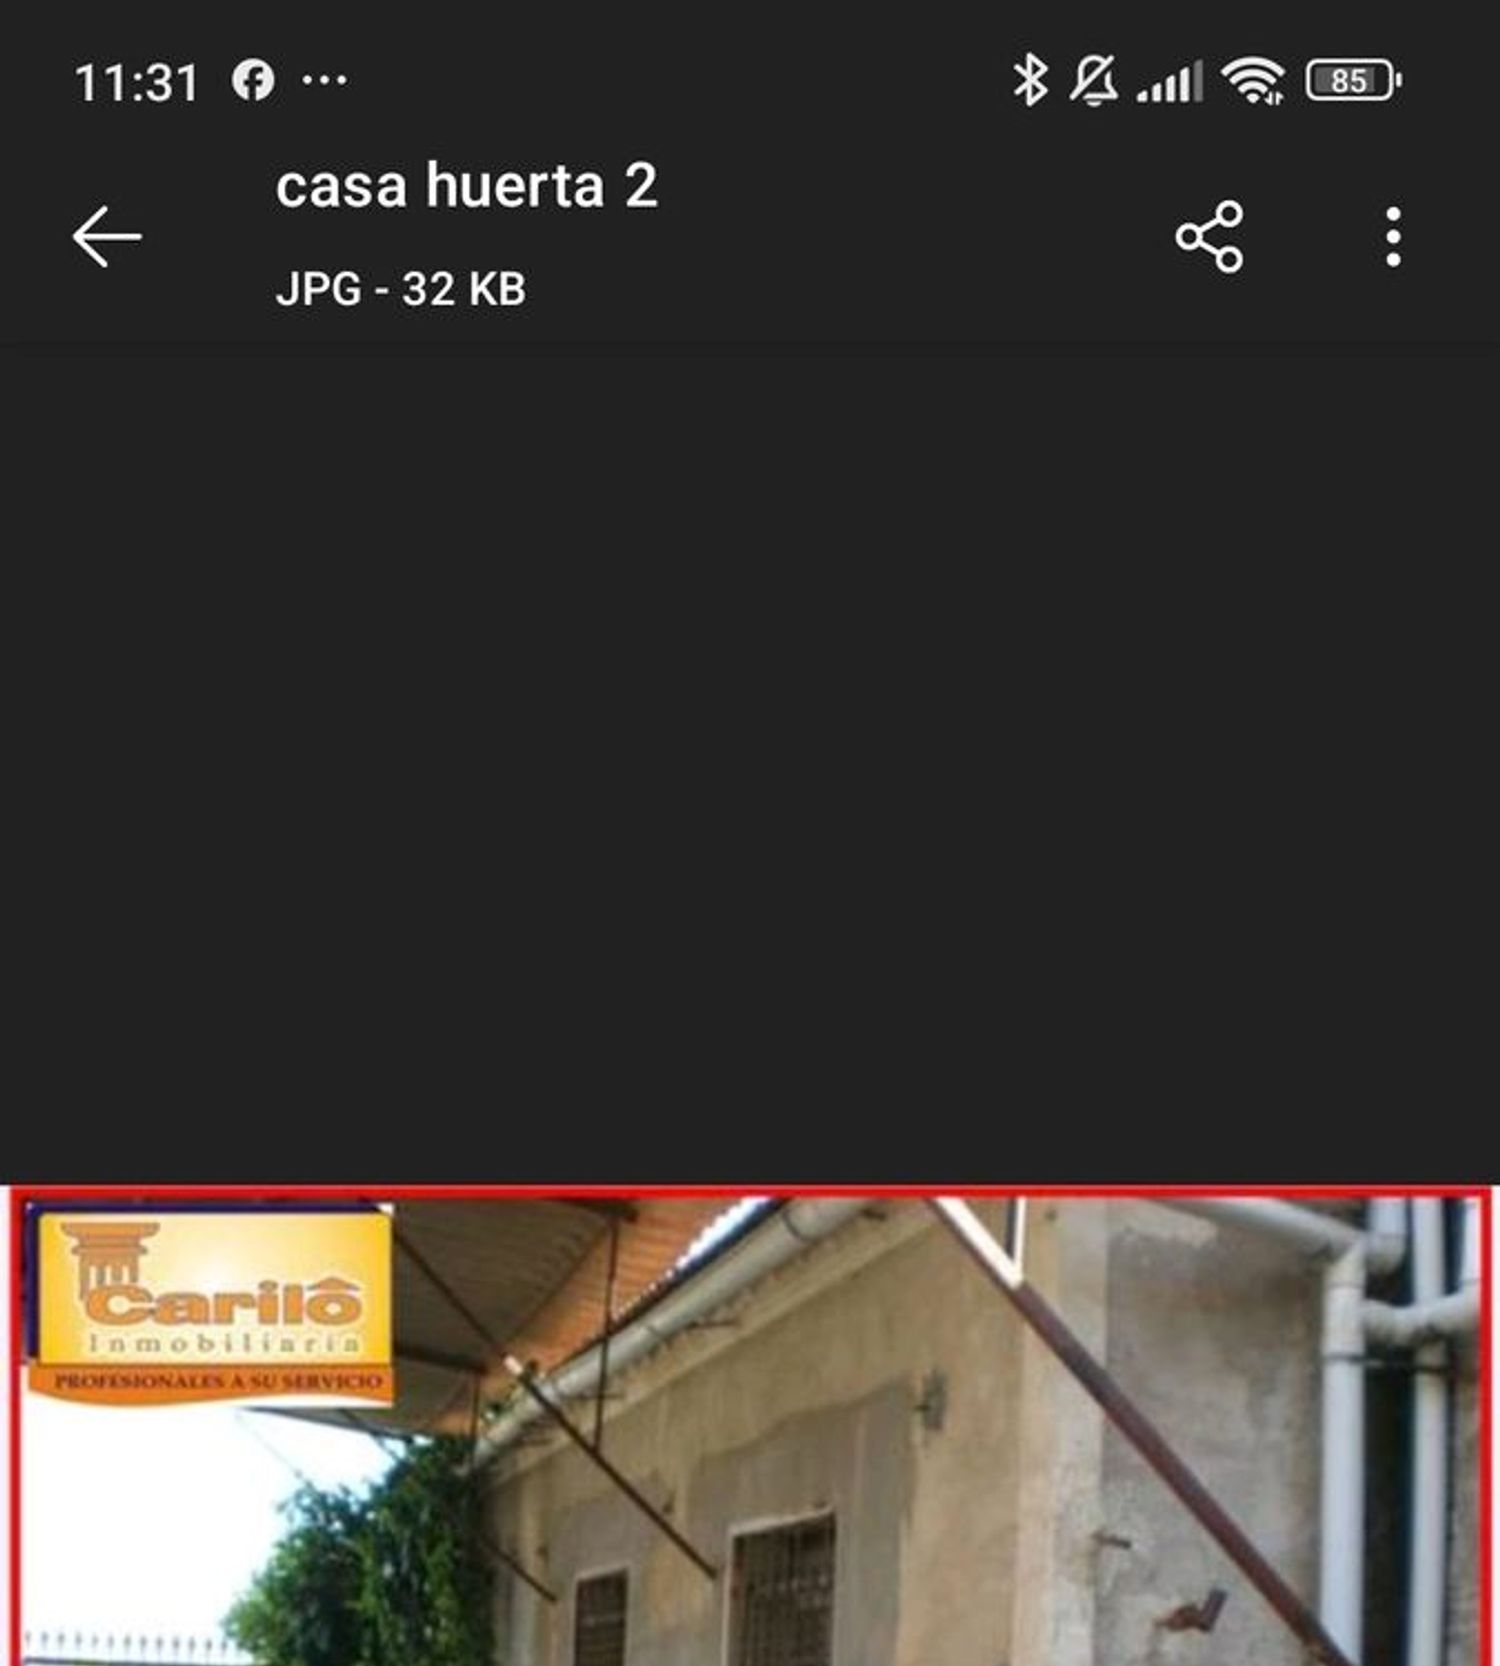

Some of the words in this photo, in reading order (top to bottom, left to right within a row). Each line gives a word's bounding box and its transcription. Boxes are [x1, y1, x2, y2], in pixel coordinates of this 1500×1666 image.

[75, 62, 197, 102] 11:31
[1331, 68, 1368, 94] 85
[276, 169, 406, 208] casa
[427, 160, 604, 208] huerta
[625, 161, 658, 207] 2
[276, 271, 361, 306] JPG
[402, 271, 455, 306] 32
[471, 271, 526, 305] KB
